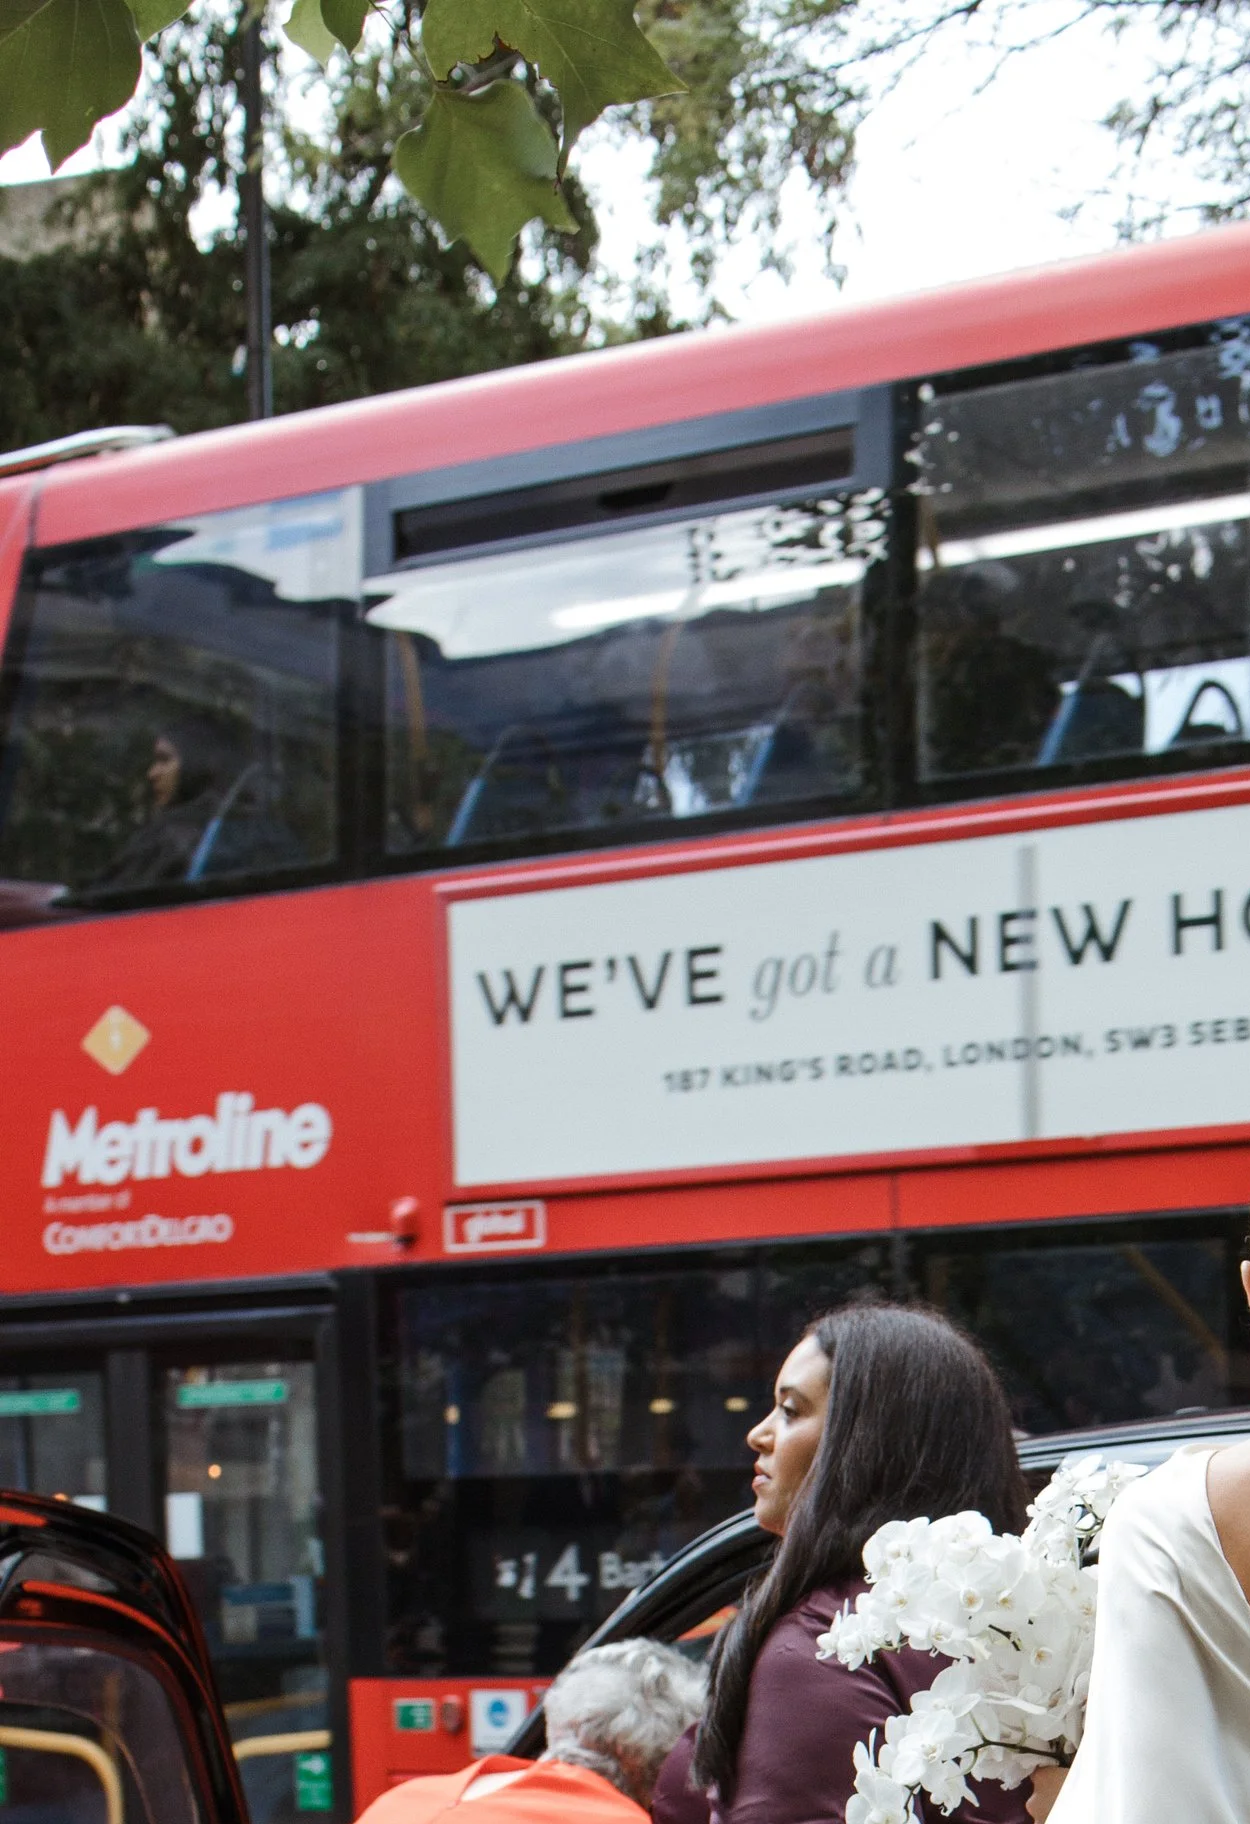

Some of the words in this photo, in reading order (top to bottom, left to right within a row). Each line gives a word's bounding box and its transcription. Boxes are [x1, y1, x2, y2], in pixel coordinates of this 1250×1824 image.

[475, 943, 727, 1027] WE'VE
[748, 930, 841, 1022] got
[863, 944, 899, 990] a
[929, 899, 1131, 981] NEW
[662, 1066, 711, 1093] 187
[721, 1055, 826, 1087] KING'S
[834, 1046, 934, 1078] ROAD,
[943, 1032, 1094, 1068] LONDON,
[1104, 1023, 1178, 1054] SW3
[41, 1090, 333, 1189] Metroline
